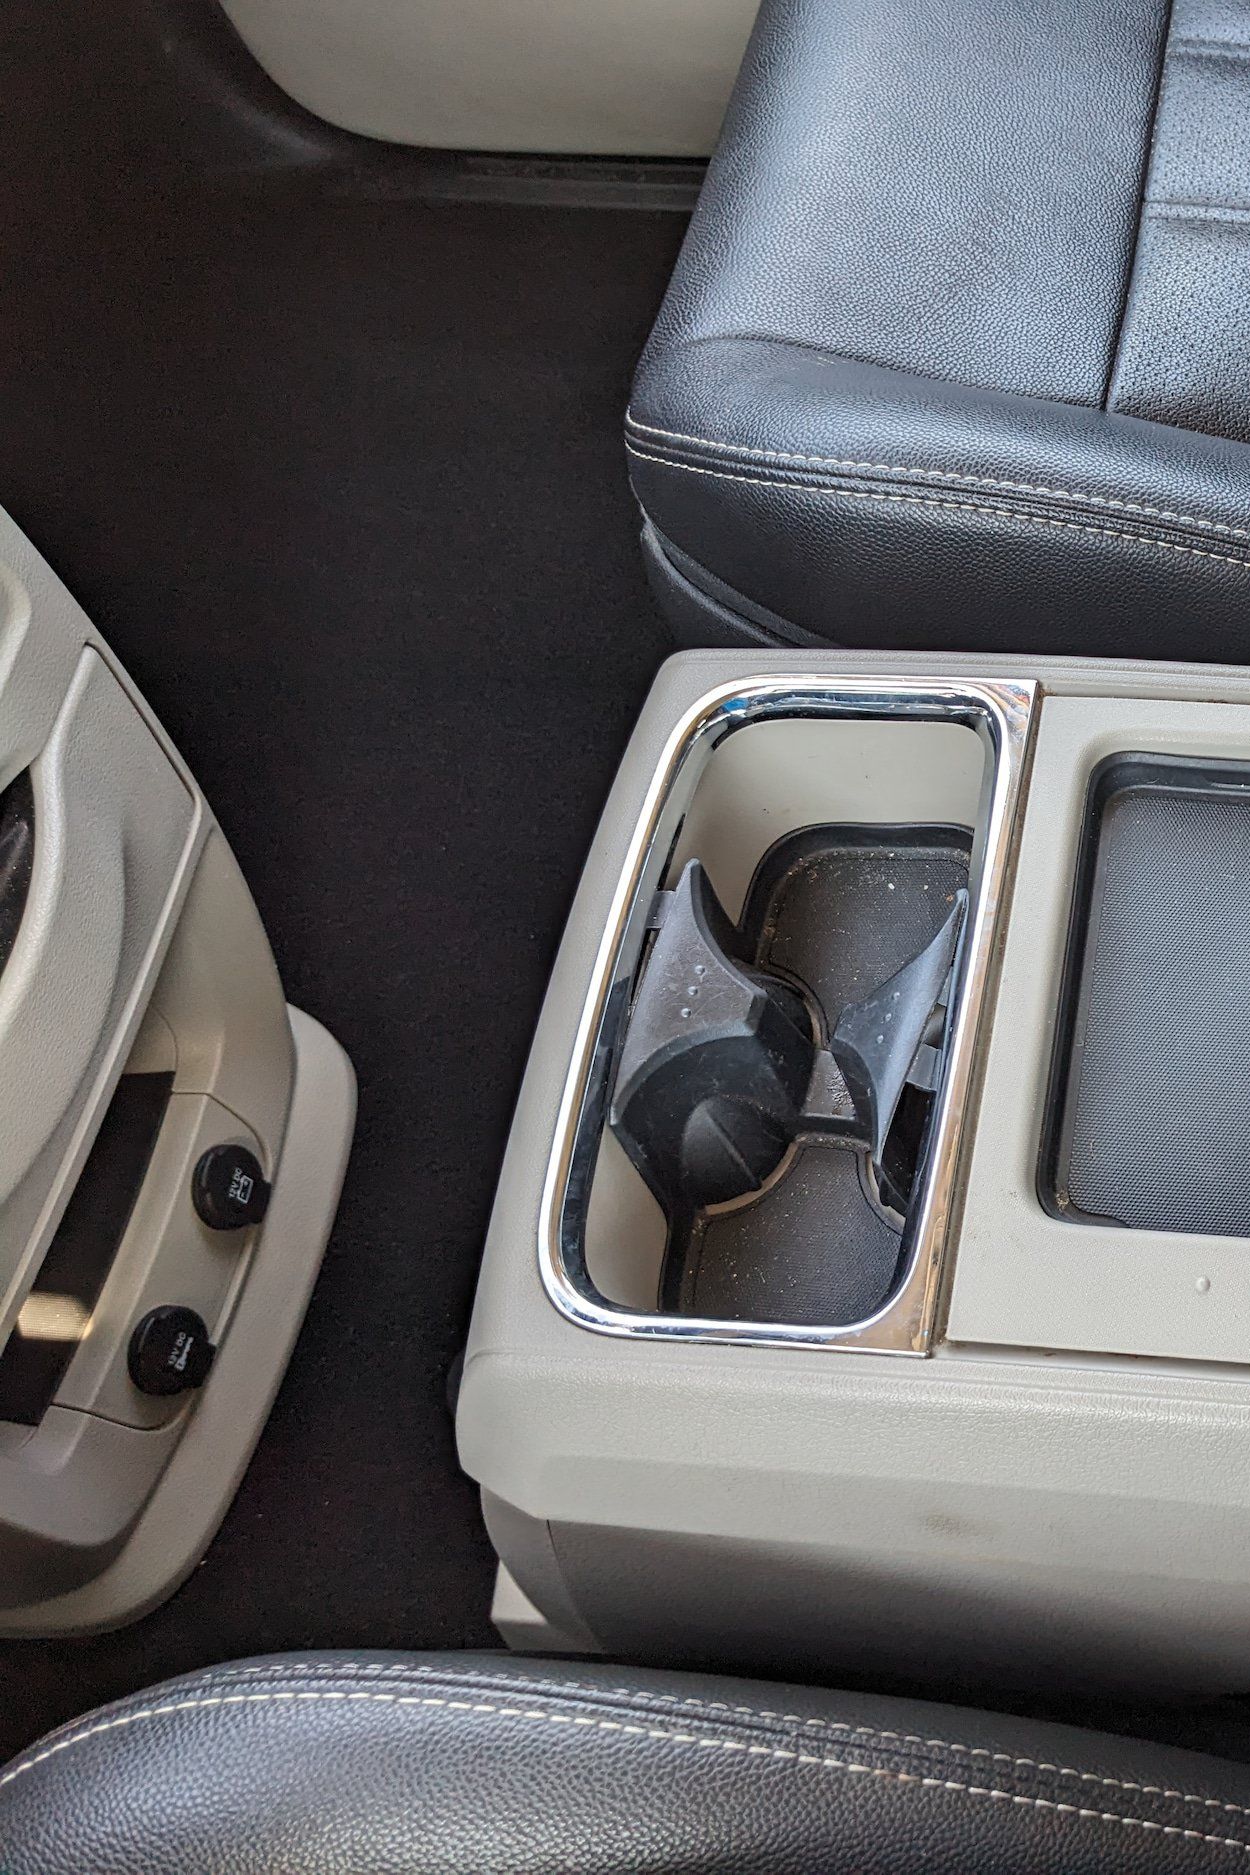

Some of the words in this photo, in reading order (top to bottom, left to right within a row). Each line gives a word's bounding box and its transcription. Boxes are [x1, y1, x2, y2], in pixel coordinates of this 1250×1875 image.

[229, 1181, 239, 1198] 12V
[234, 1167, 242, 1181] DC
[168, 1347, 179, 1364] 12V
[175, 1331, 186, 1347] DC
